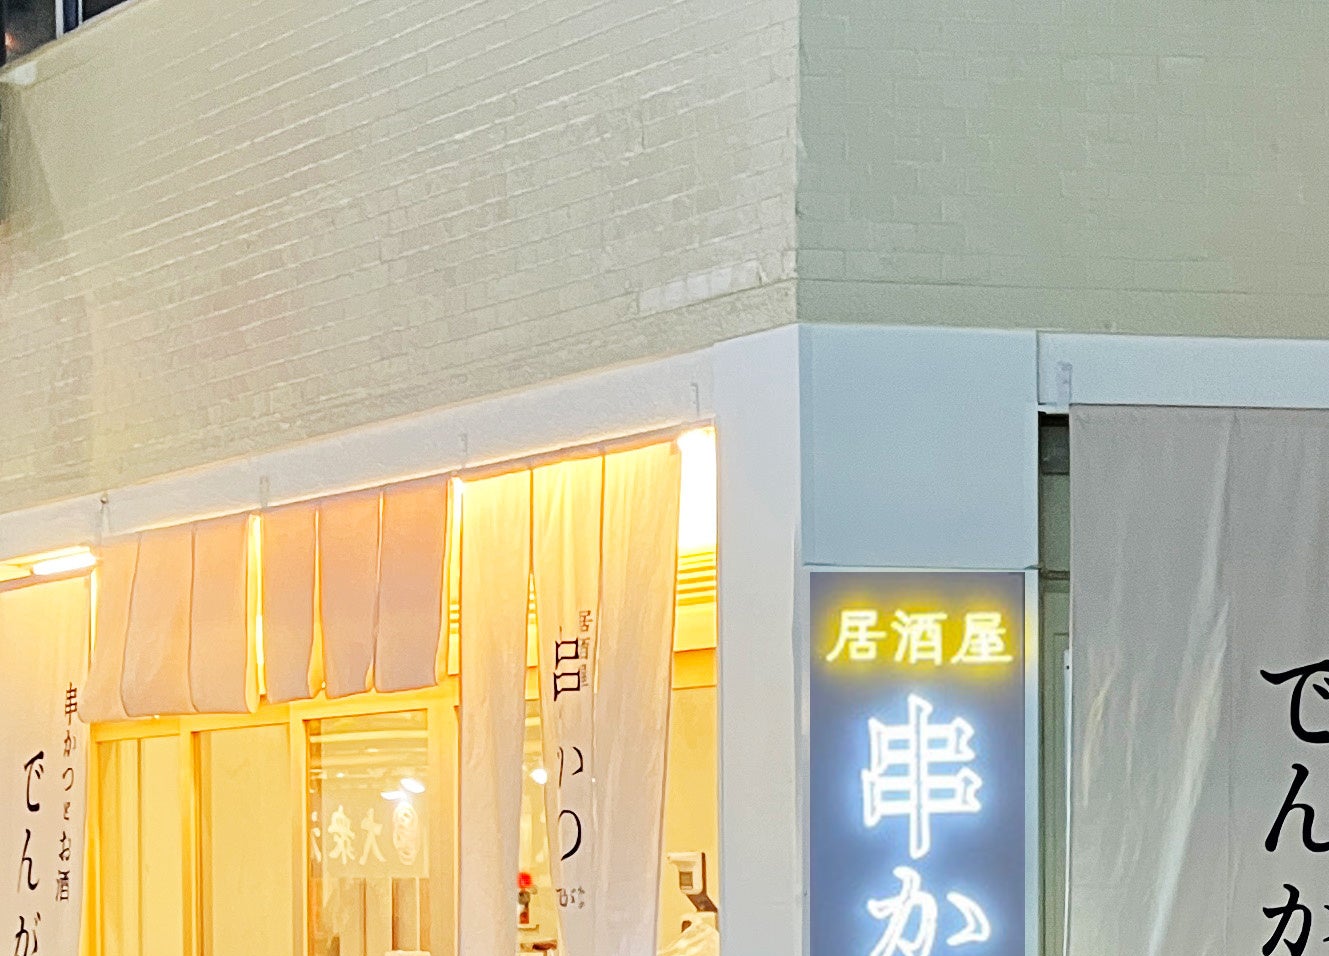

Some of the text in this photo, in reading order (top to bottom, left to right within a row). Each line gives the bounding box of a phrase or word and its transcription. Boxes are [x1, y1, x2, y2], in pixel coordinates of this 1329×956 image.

[825, 608, 1013, 666] 居酒屋
[55, 681, 78, 903] 串かつとお酒
